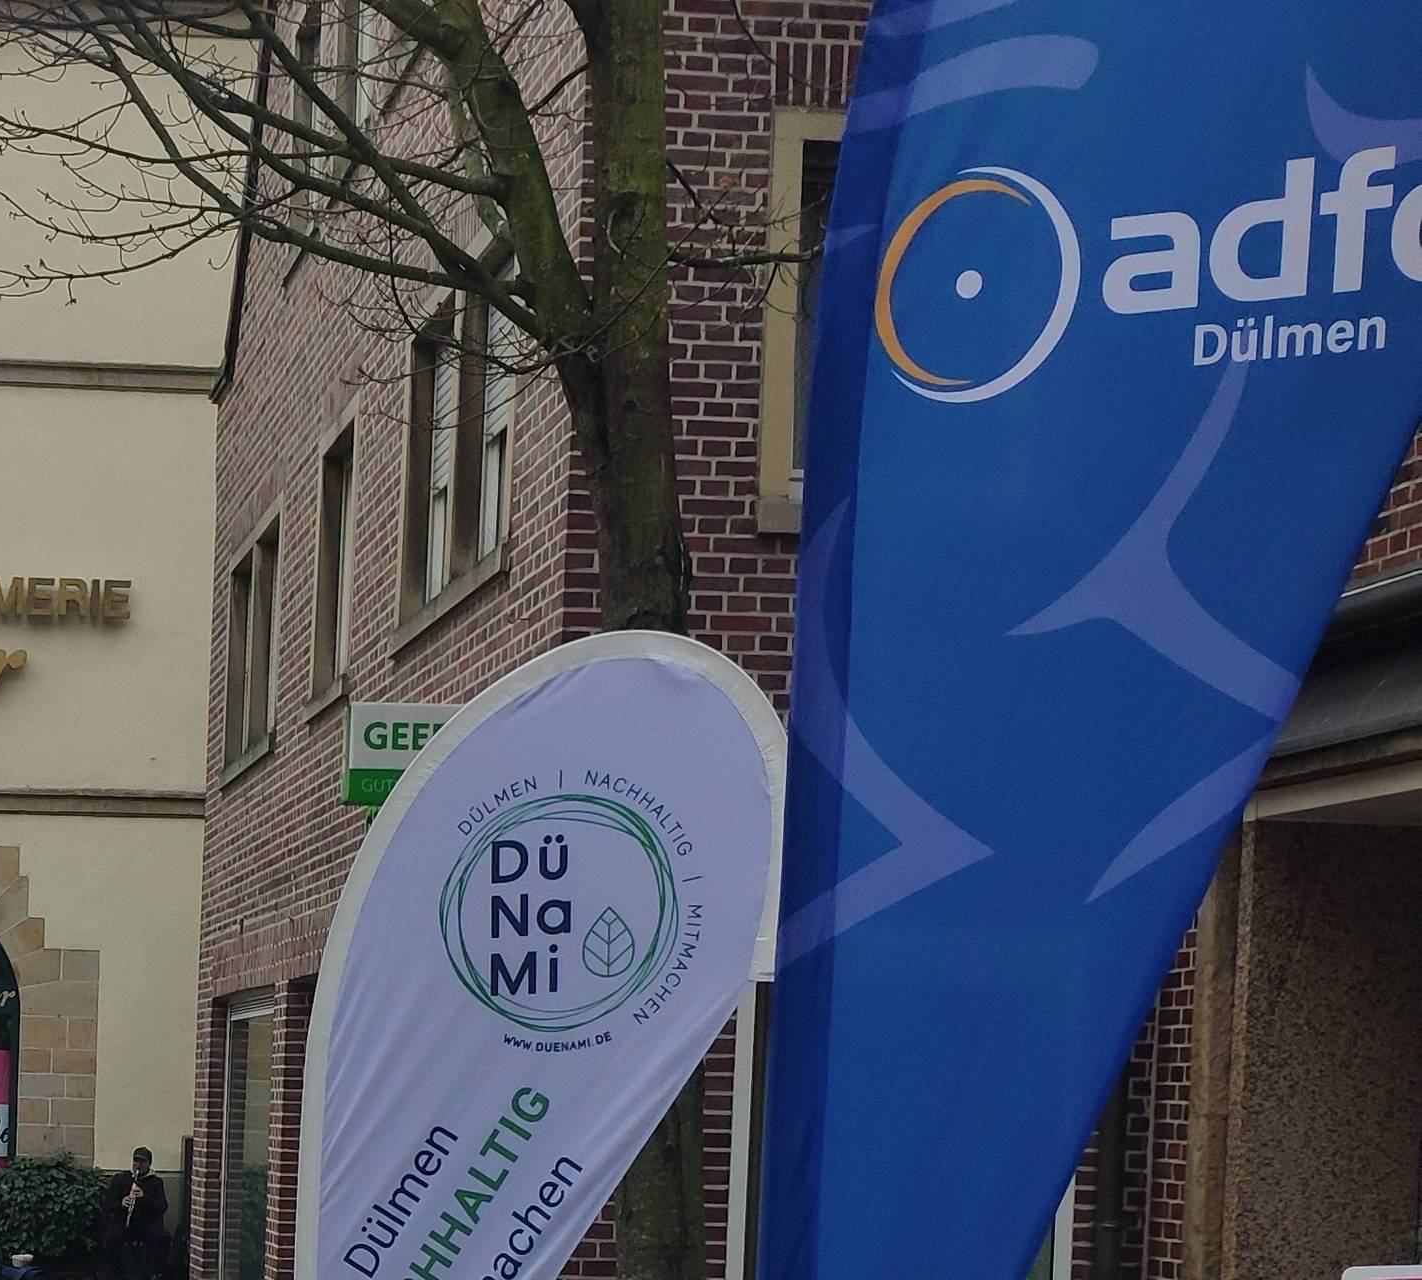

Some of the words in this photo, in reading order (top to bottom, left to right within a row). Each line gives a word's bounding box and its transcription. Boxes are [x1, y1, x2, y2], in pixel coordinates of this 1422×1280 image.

[1193, 314, 1387, 366] Dülmen
[457, 775, 538, 837] DÜLMEN
[583, 769, 694, 857] NACHHALTIG
[490, 834, 569, 884] Dü
[490, 893, 572, 939] Na
[490, 944, 558, 996] Mi
[632, 903, 704, 1026] MITMACHEN
[503, 1030, 613, 1053] WWW.DUENAMI.DE
[343, 1126, 459, 1279] Dülmen
[403, 1087, 550, 1280] HHALTIG
[482, 1156, 583, 1280] achen
